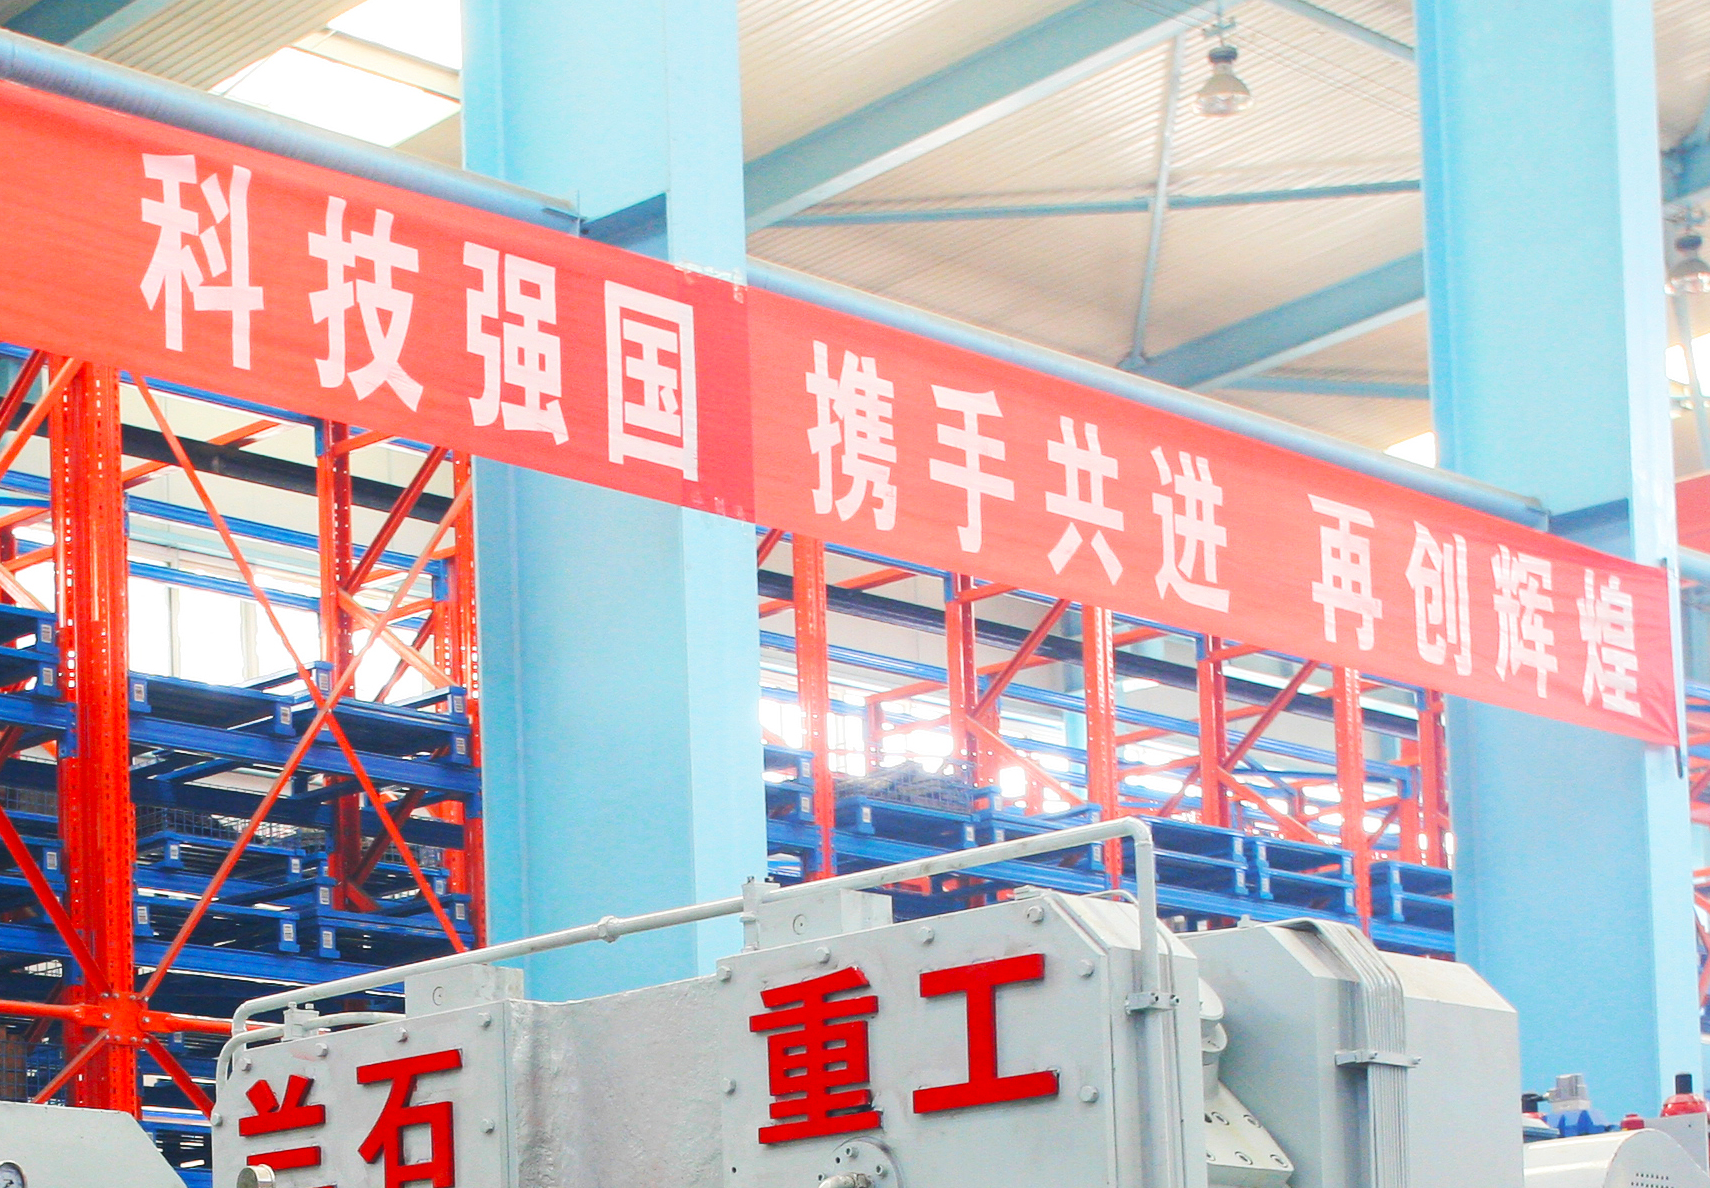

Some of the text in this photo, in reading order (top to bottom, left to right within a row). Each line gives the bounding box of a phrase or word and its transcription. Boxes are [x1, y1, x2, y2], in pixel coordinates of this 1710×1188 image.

[140, 153, 699, 481] 科技强国
[804, 339, 1233, 615] 携手共进
[1308, 493, 1643, 719] 再创辉煌
[750, 953, 1059, 1145] 重工
